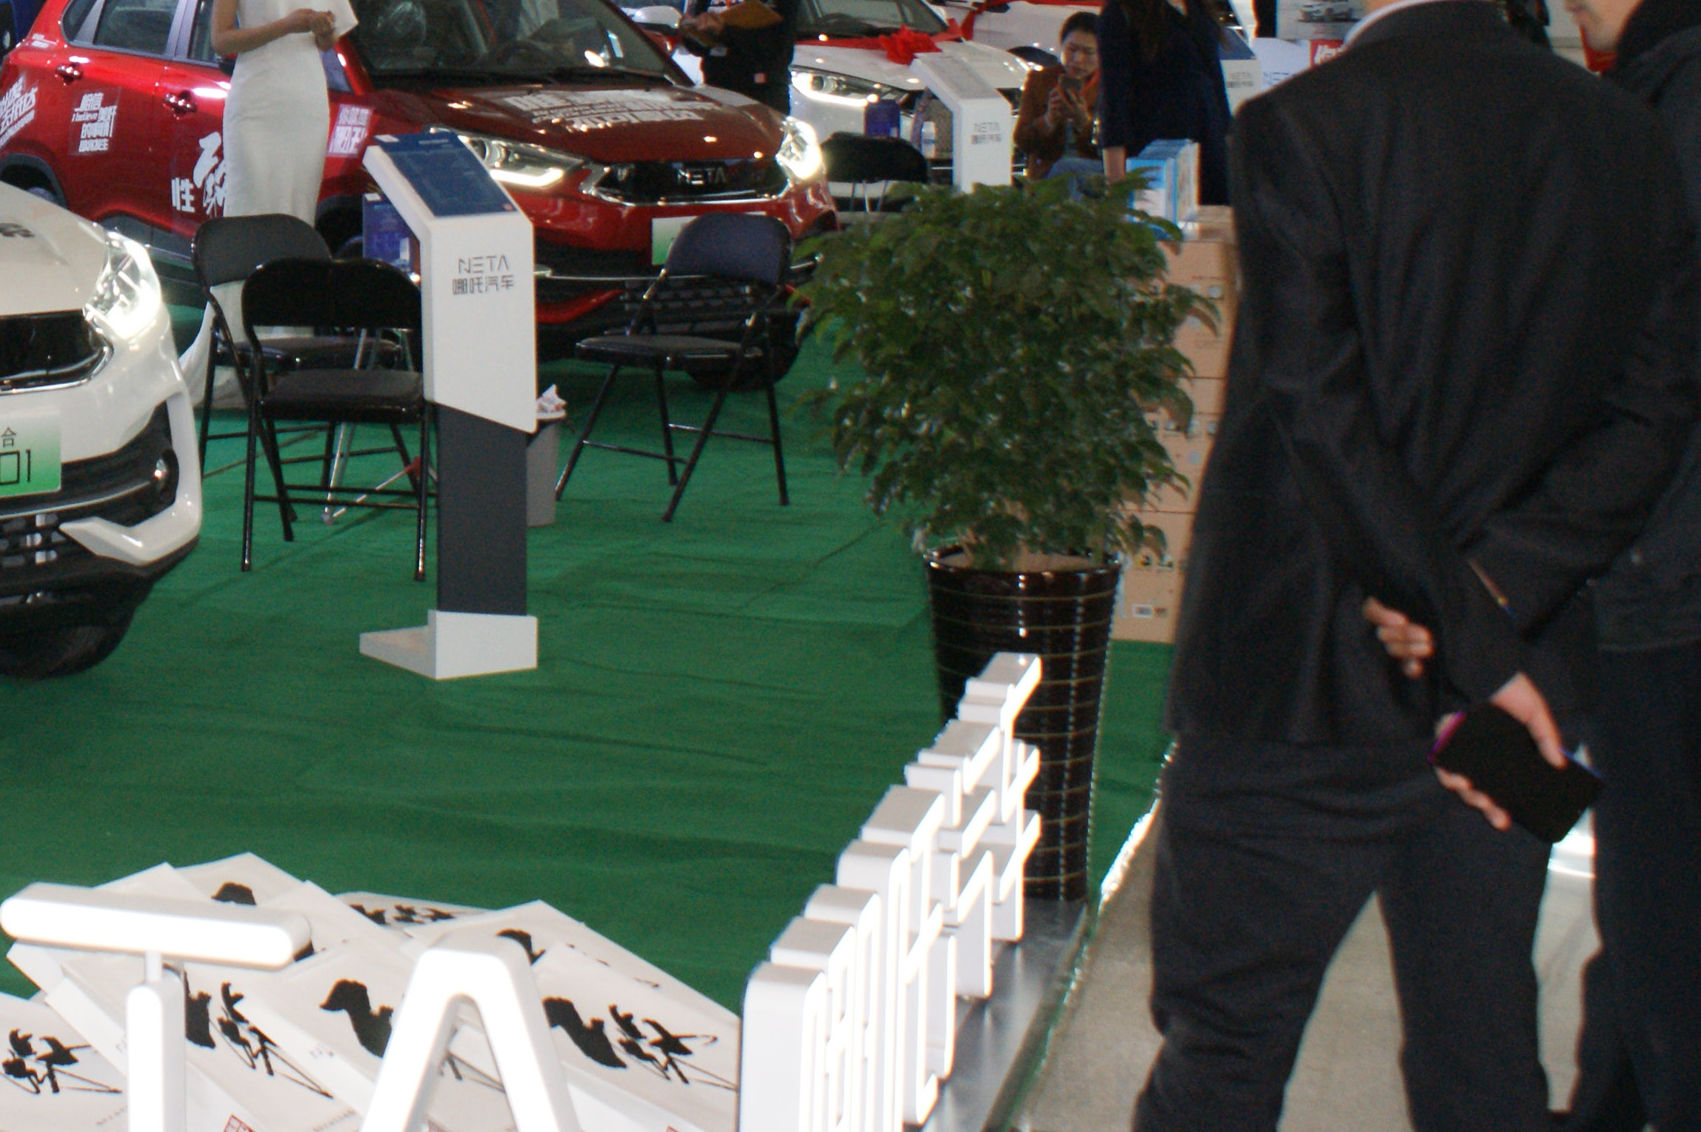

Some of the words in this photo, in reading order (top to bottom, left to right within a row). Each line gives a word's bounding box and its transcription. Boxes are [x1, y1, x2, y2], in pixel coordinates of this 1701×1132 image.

[457, 254, 510, 275] NETA
[452, 274, 515, 296] 哪吒汽车
